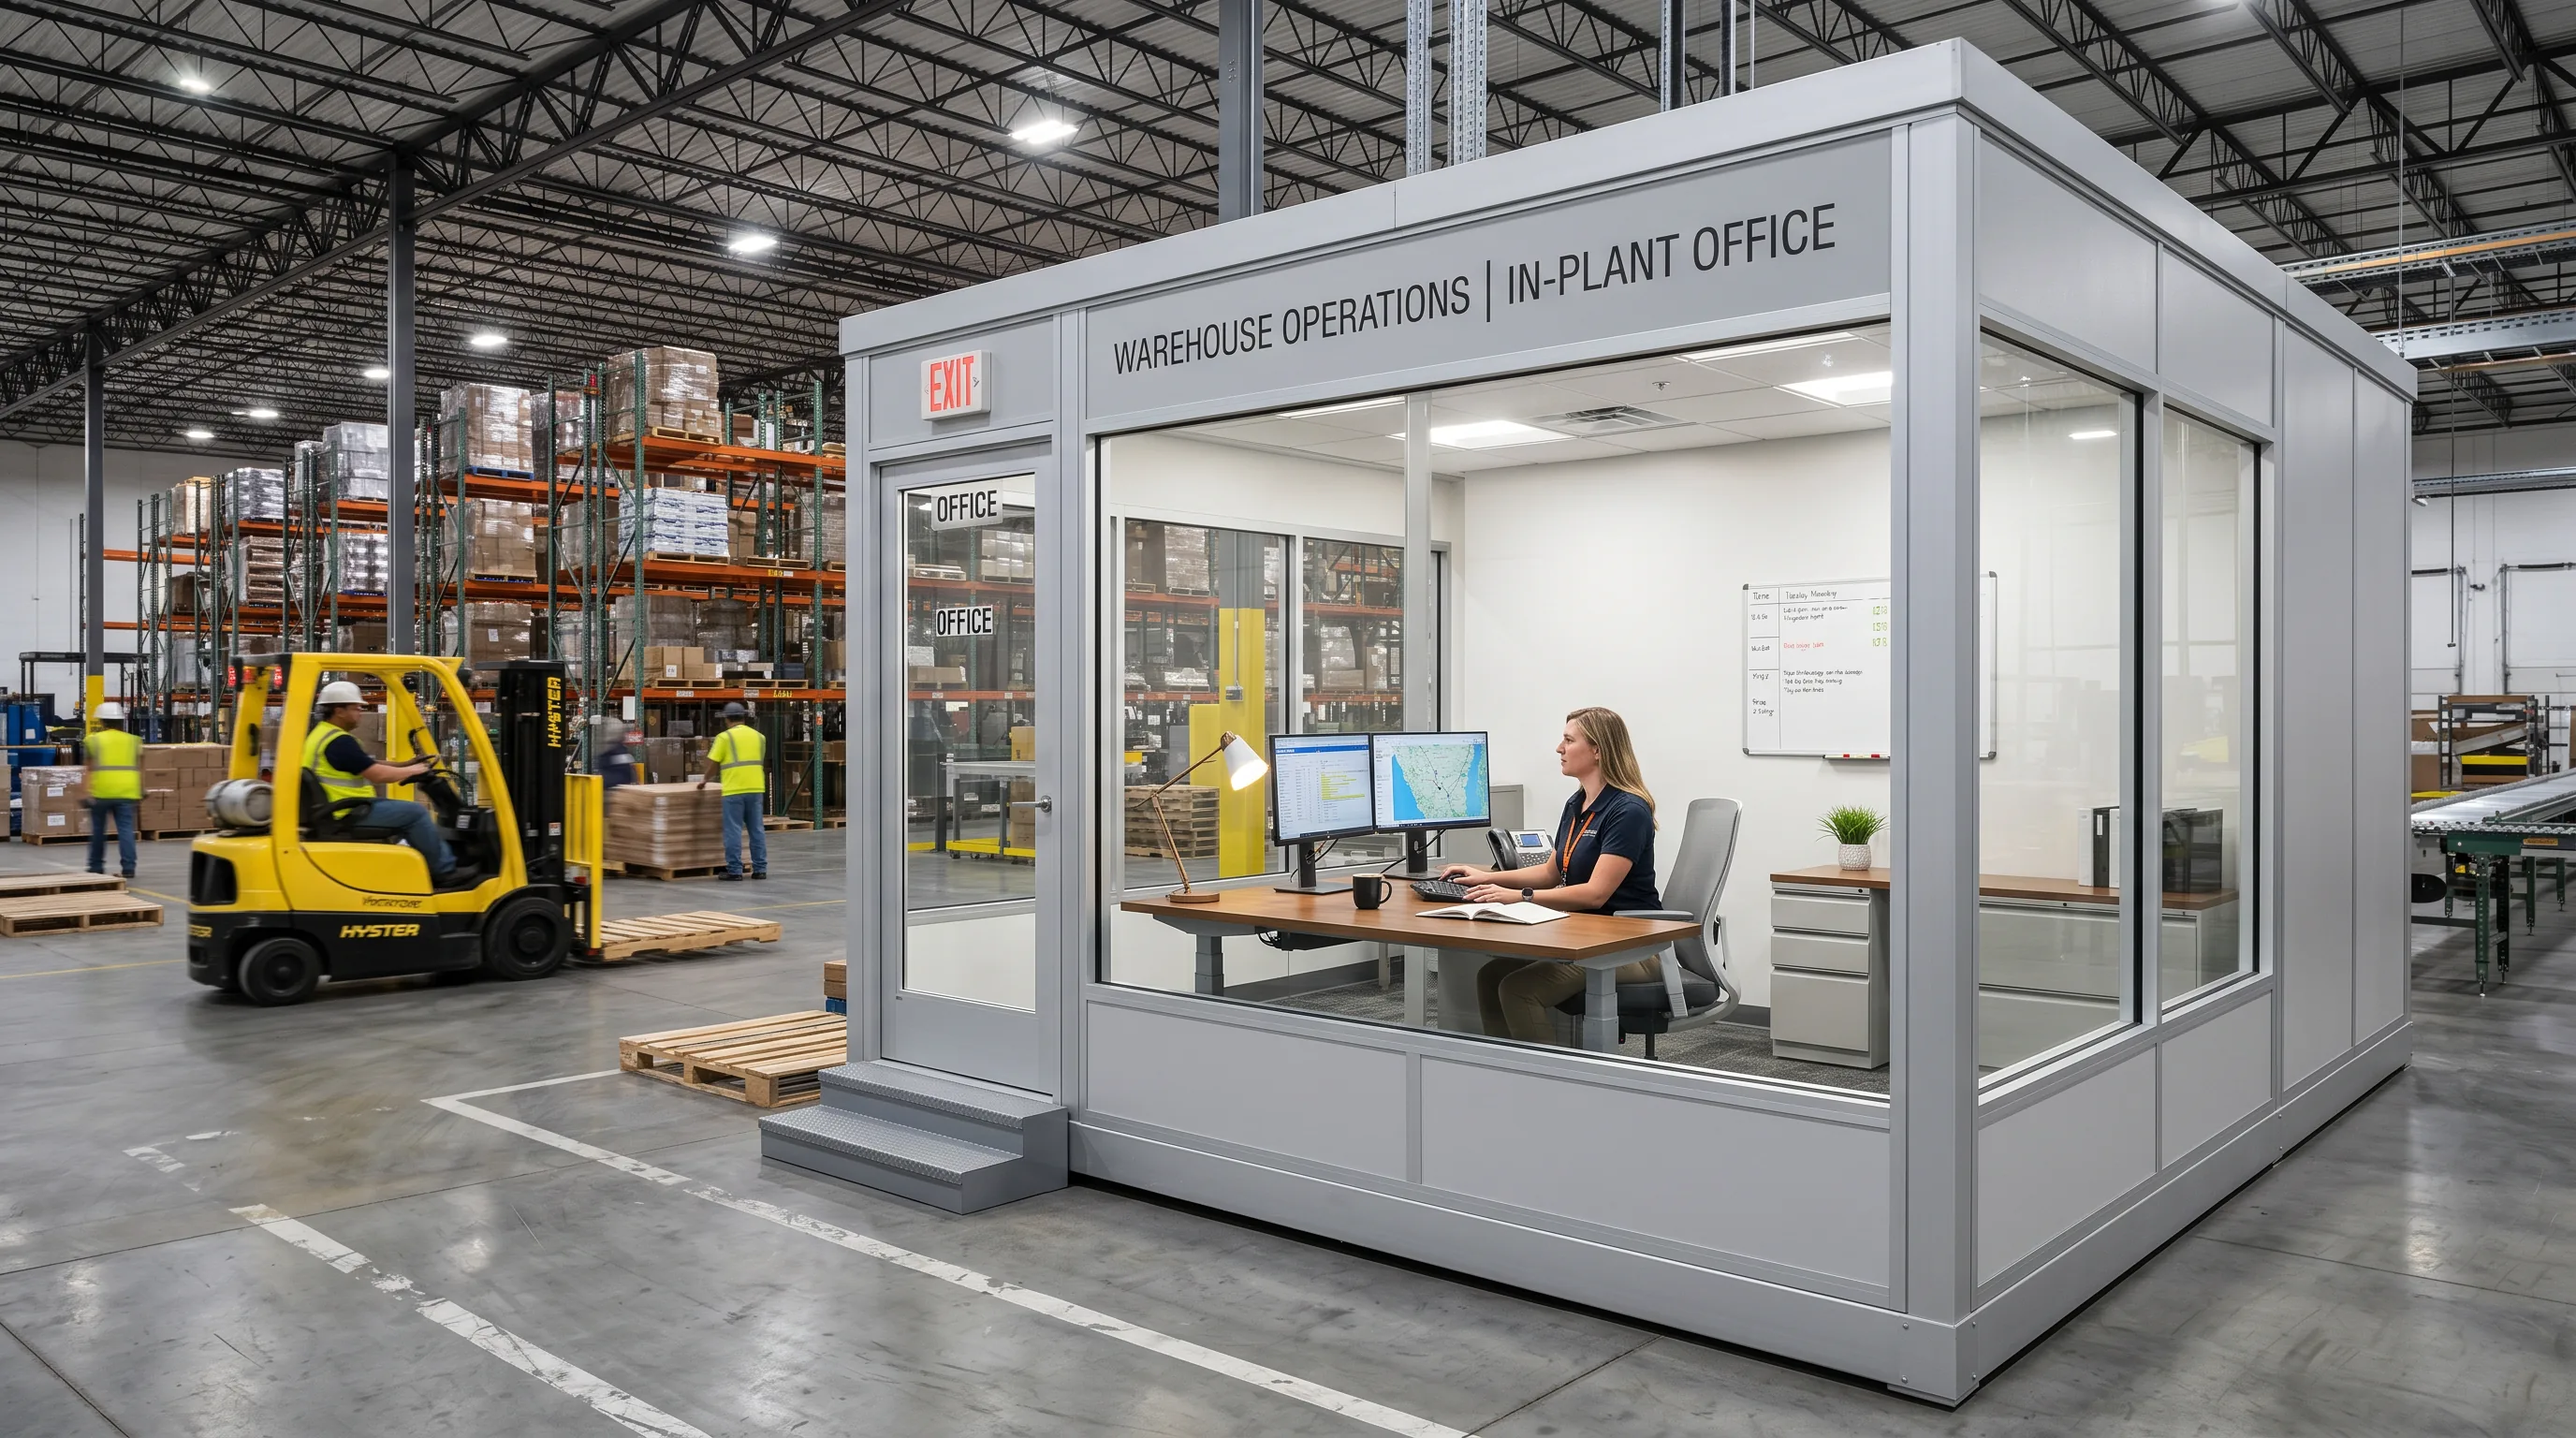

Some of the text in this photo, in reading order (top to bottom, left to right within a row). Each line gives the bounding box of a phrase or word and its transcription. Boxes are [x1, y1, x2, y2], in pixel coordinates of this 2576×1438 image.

[1114, 202, 1836, 374] WAREHOUSE OPERATIONS IN-PLANT OFFICE
[929, 355, 974, 412] EXIT
[937, 490, 998, 522] OFFICE
[937, 608, 992, 636] OFFICE
[340, 923, 421, 938] HYSTER
